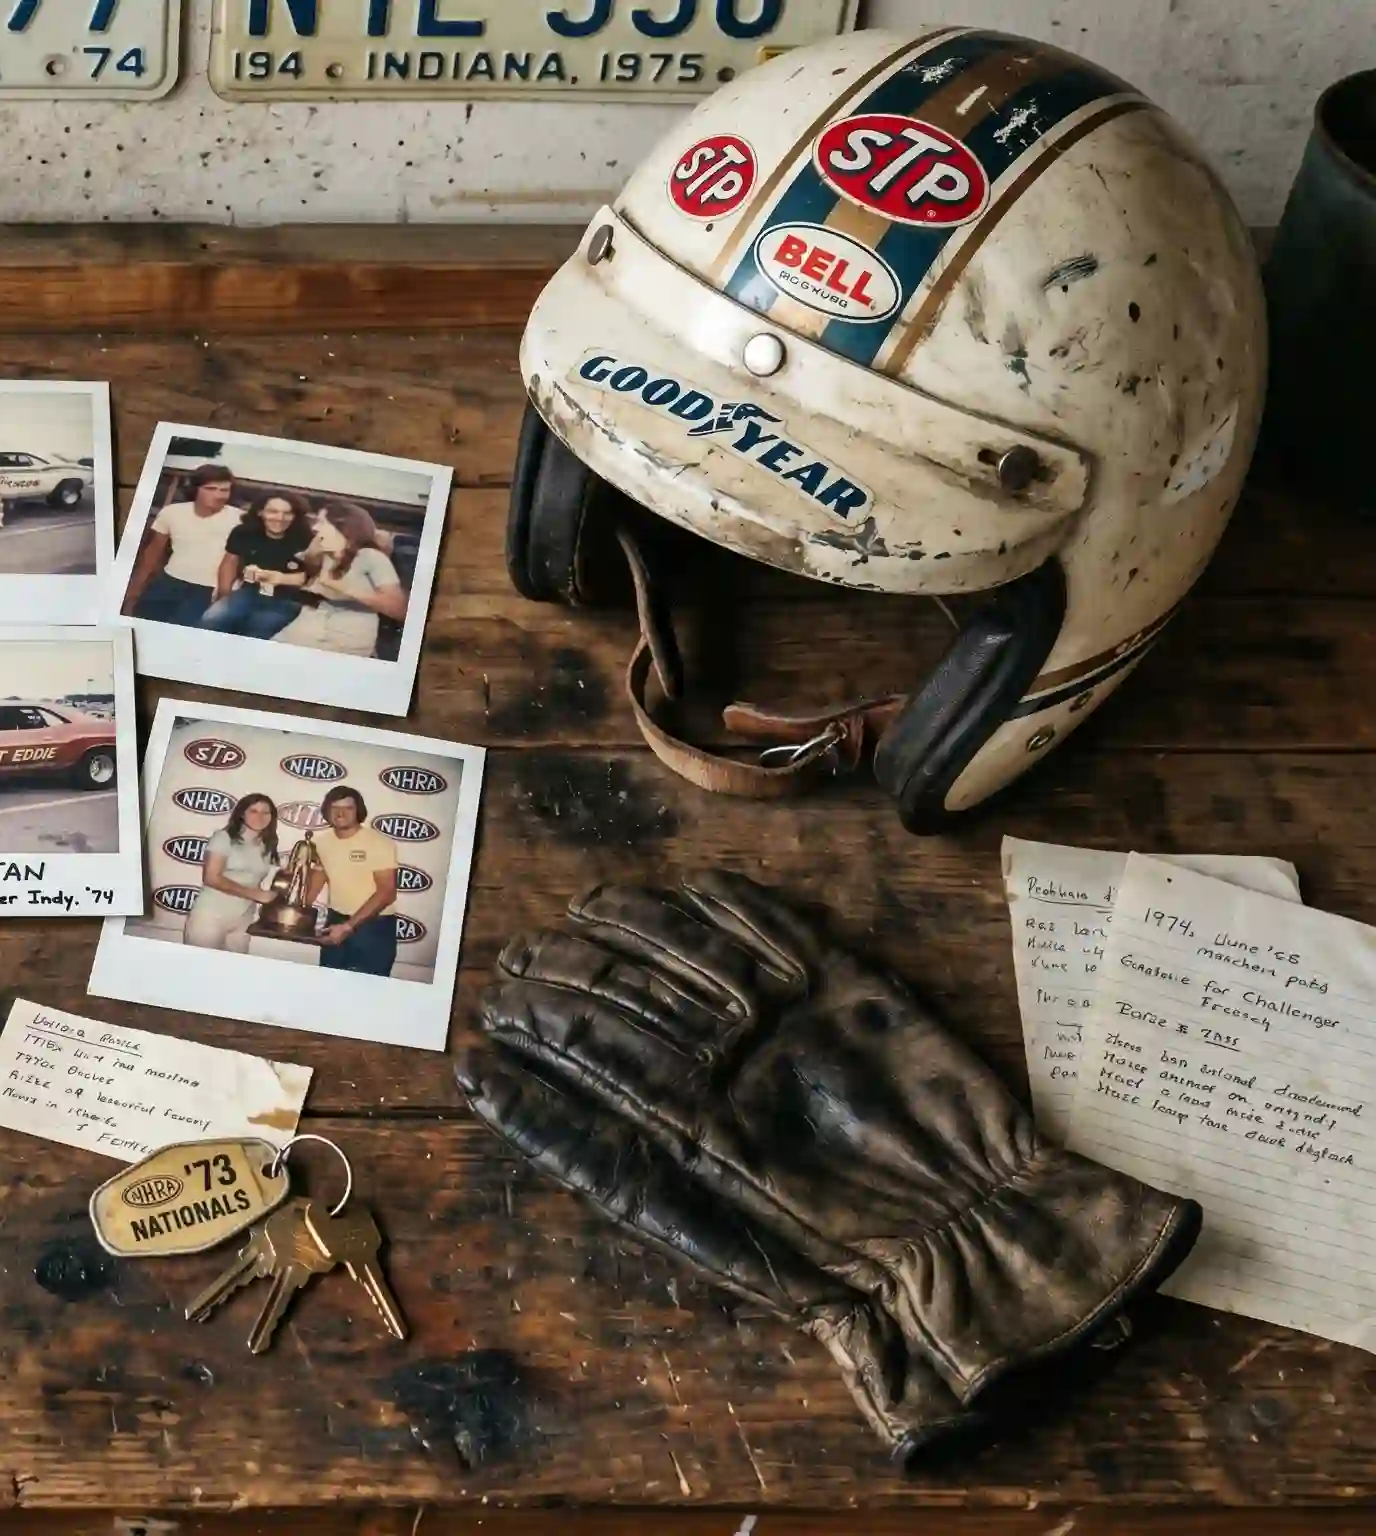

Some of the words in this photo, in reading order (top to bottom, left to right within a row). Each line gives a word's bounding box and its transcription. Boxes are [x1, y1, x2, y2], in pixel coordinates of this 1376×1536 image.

[232, 51, 305, 81] 194
[600, 51, 704, 83] 1975
[675, 144, 747, 205] STP
[828, 127, 972, 205] STP
[773, 233, 875, 307] BELL
[11, 747, 58, 762] EDDIE
[195, 743, 239, 765] STP
[289, 758, 338, 778] NHRA
[388, 770, 439, 791] NHRA
[182, 792, 231, 812] NHRA
[380, 818, 429, 838] NHRA
[183, 1153, 237, 1192] '73
[130, 1188, 251, 1242] NATIONALS
